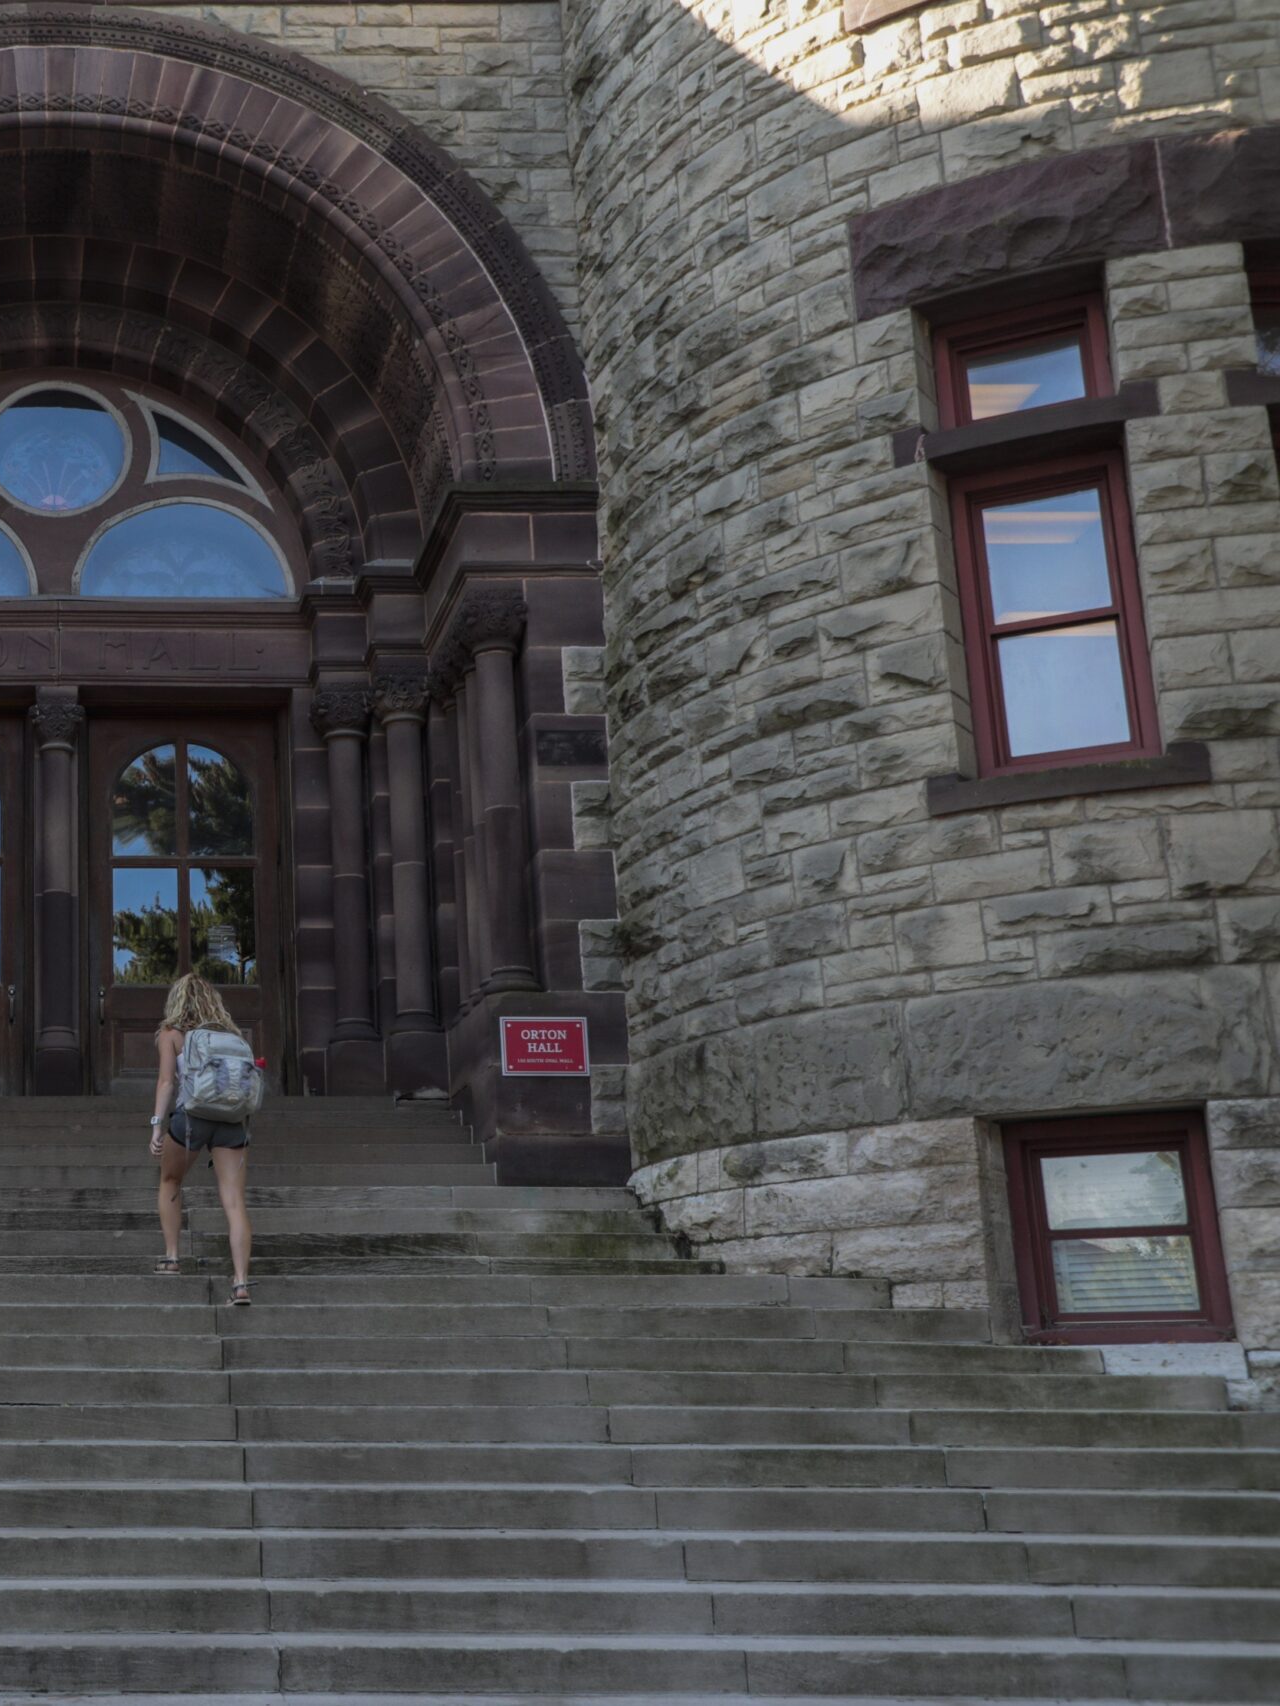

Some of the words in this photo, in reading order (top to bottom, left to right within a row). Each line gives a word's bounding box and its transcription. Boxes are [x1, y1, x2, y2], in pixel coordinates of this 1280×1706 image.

[97, 633, 261, 671] HALL
[520, 1029, 567, 1040] ORTON
[527, 1042, 562, 1053] HALL
